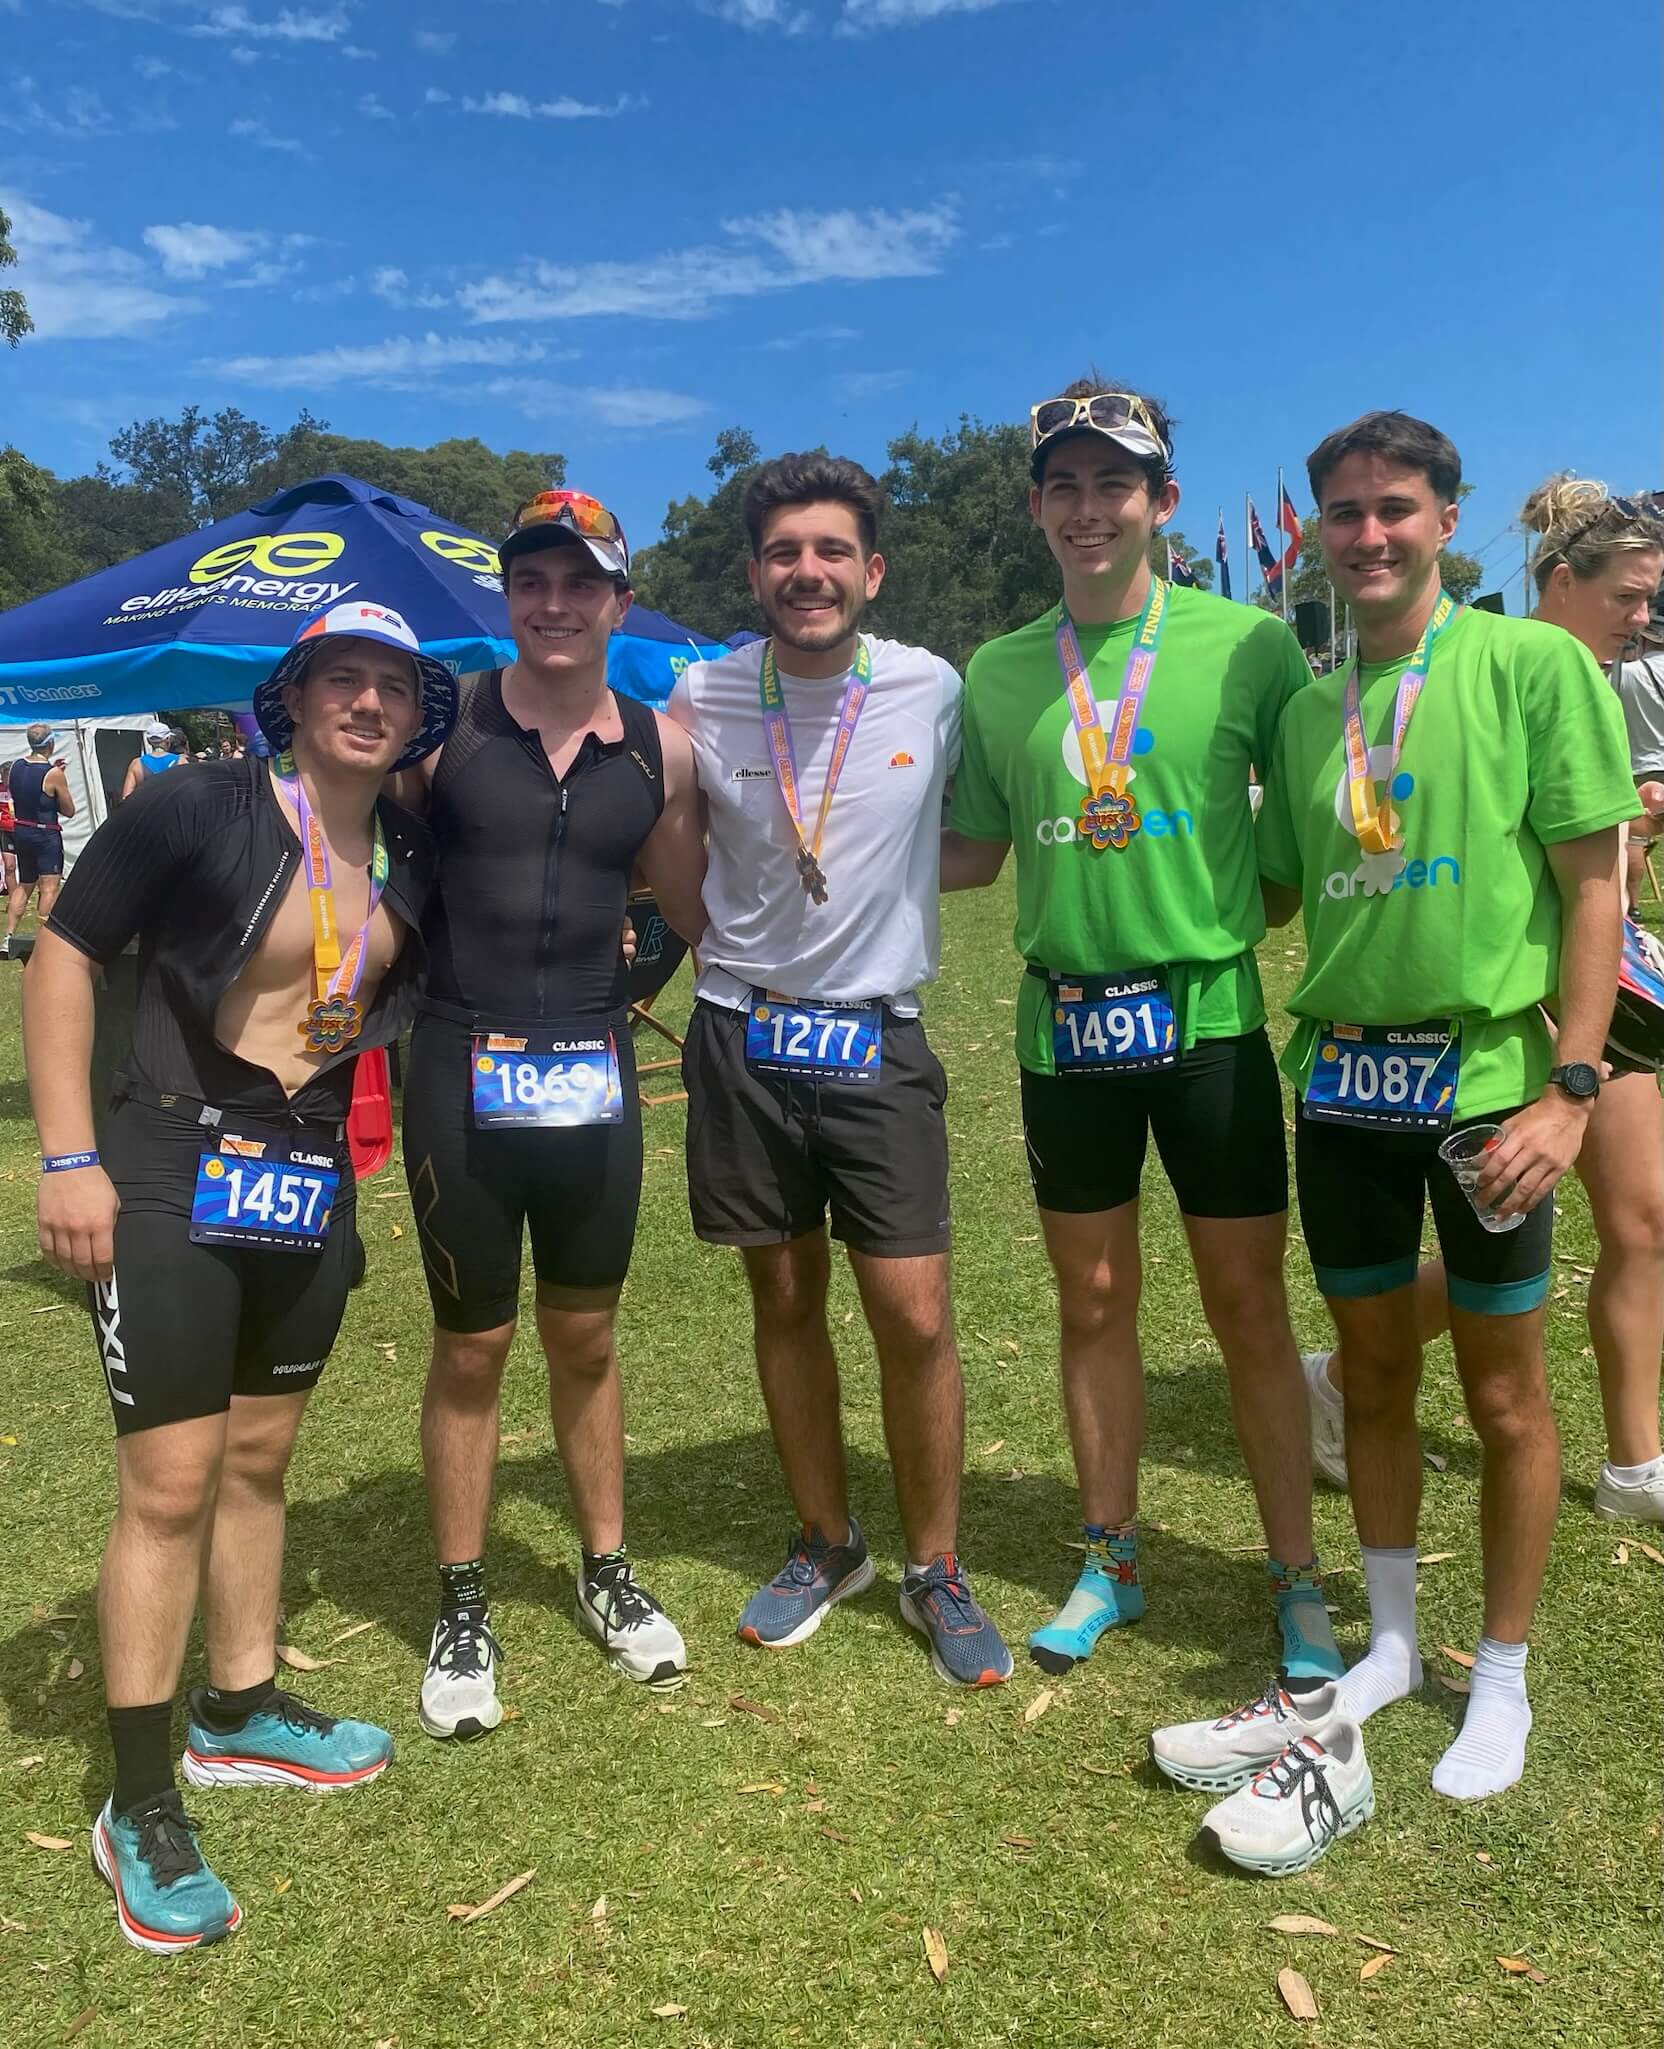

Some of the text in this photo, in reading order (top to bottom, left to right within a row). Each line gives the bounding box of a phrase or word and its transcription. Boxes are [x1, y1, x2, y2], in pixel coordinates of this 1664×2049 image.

[103, 608, 168, 625] MAKING
[168, 595, 229, 614] EVENTS
[1139, 576, 1165, 645] FINISHE
[17, 684, 102, 703] banners
[735, 768, 772, 778] ellesse
[240, 924, 254, 947] HUMAN
[1104, 979, 1158, 998] CLASSIC
[823, 1000, 872, 1010] CLASSIC
[770, 1013, 860, 1060] 1277
[1066, 1003, 1157, 1056] 1491
[1386, 1032, 1450, 1044] CLASSIC
[552, 1040, 606, 1052] CLASSIC
[496, 1062, 594, 1106] 1869
[1338, 1052, 1436, 1104] 1087
[51, 1155, 91, 1168] CLASSIC
[289, 1150, 334, 1168] CLASSIC
[225, 1168, 322, 1227] 1457
